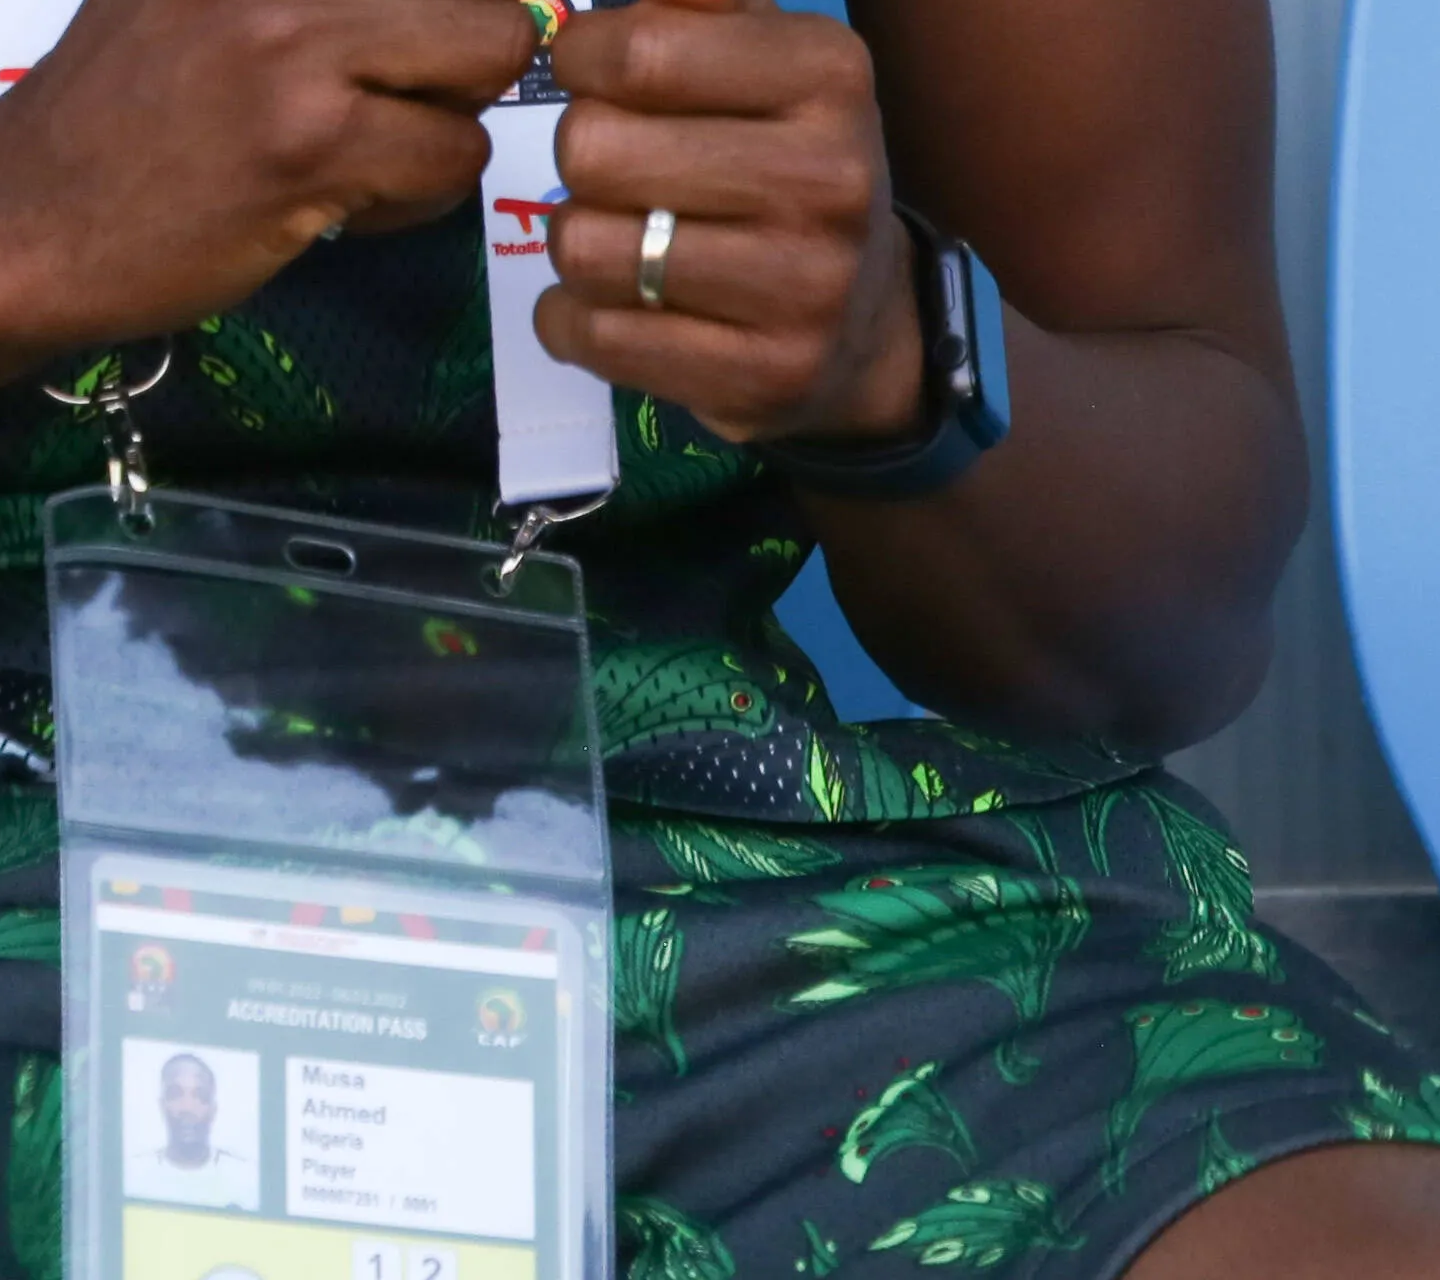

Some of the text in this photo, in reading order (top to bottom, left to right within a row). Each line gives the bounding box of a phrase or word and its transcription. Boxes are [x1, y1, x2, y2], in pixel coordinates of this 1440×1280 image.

[227, 998, 428, 1040] ACCREDITATION PASS
[302, 1064, 366, 1089] Musa
[301, 1098, 387, 1125] Ahmed
[301, 1127, 364, 1150] Nigeria
[301, 1158, 357, 1182] Player
[368, 1253, 443, 1280] 1 2
